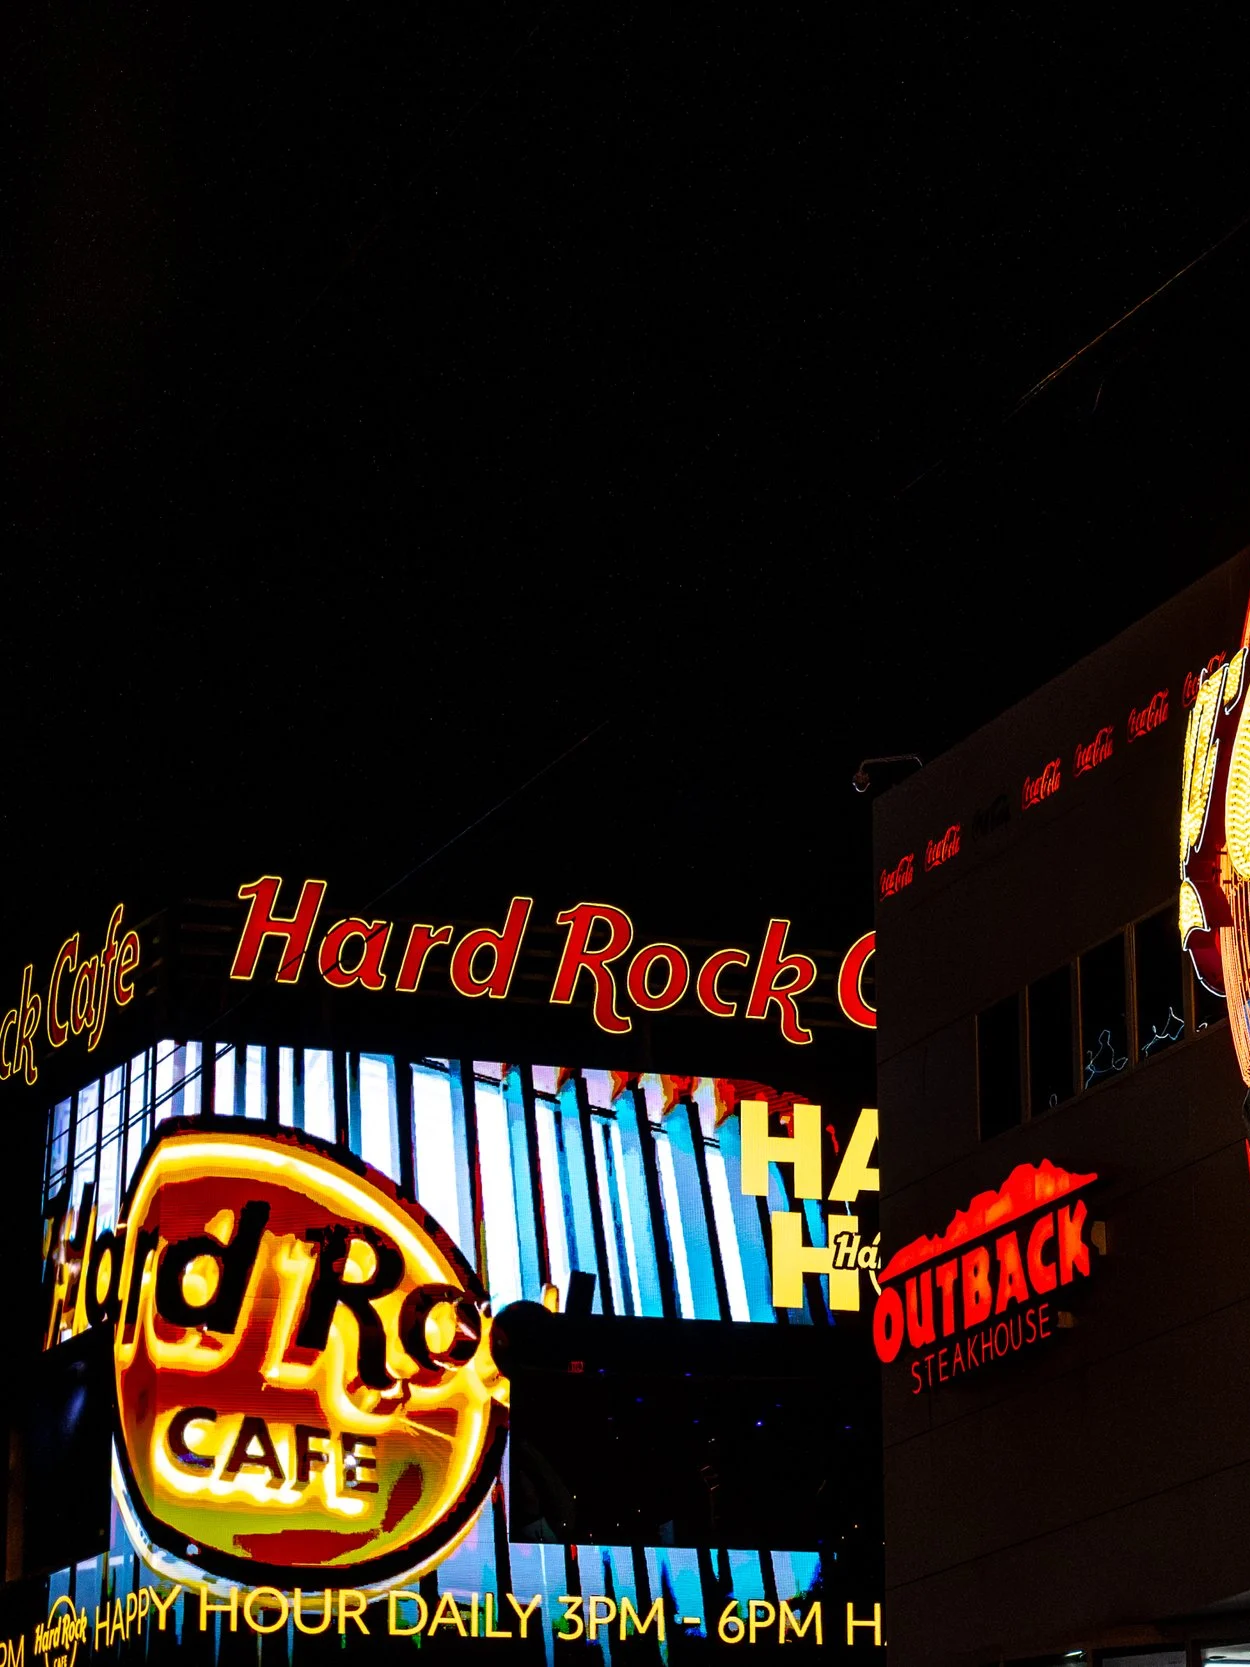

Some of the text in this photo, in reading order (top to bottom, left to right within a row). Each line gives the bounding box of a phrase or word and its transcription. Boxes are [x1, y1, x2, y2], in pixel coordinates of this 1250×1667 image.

[47, 902, 140, 1053] Cafe
[230, 875, 533, 999] Hard
[549, 902, 817, 1045] Rock
[873, 1199, 1091, 1363] OUTBACK
[911, 1302, 1052, 1394] STEAKHOUSE
[166, 1406, 379, 1493] CAFE
[34, 1606, 87, 1656] Hard Rock
[95, 1584, 182, 1651] HAPPY
[199, 1586, 368, 1635] HOUR
[388, 1588, 541, 1638] DAILY
[557, 1596, 666, 1642] 3PM
[717, 1600, 824, 1646] 6PM
